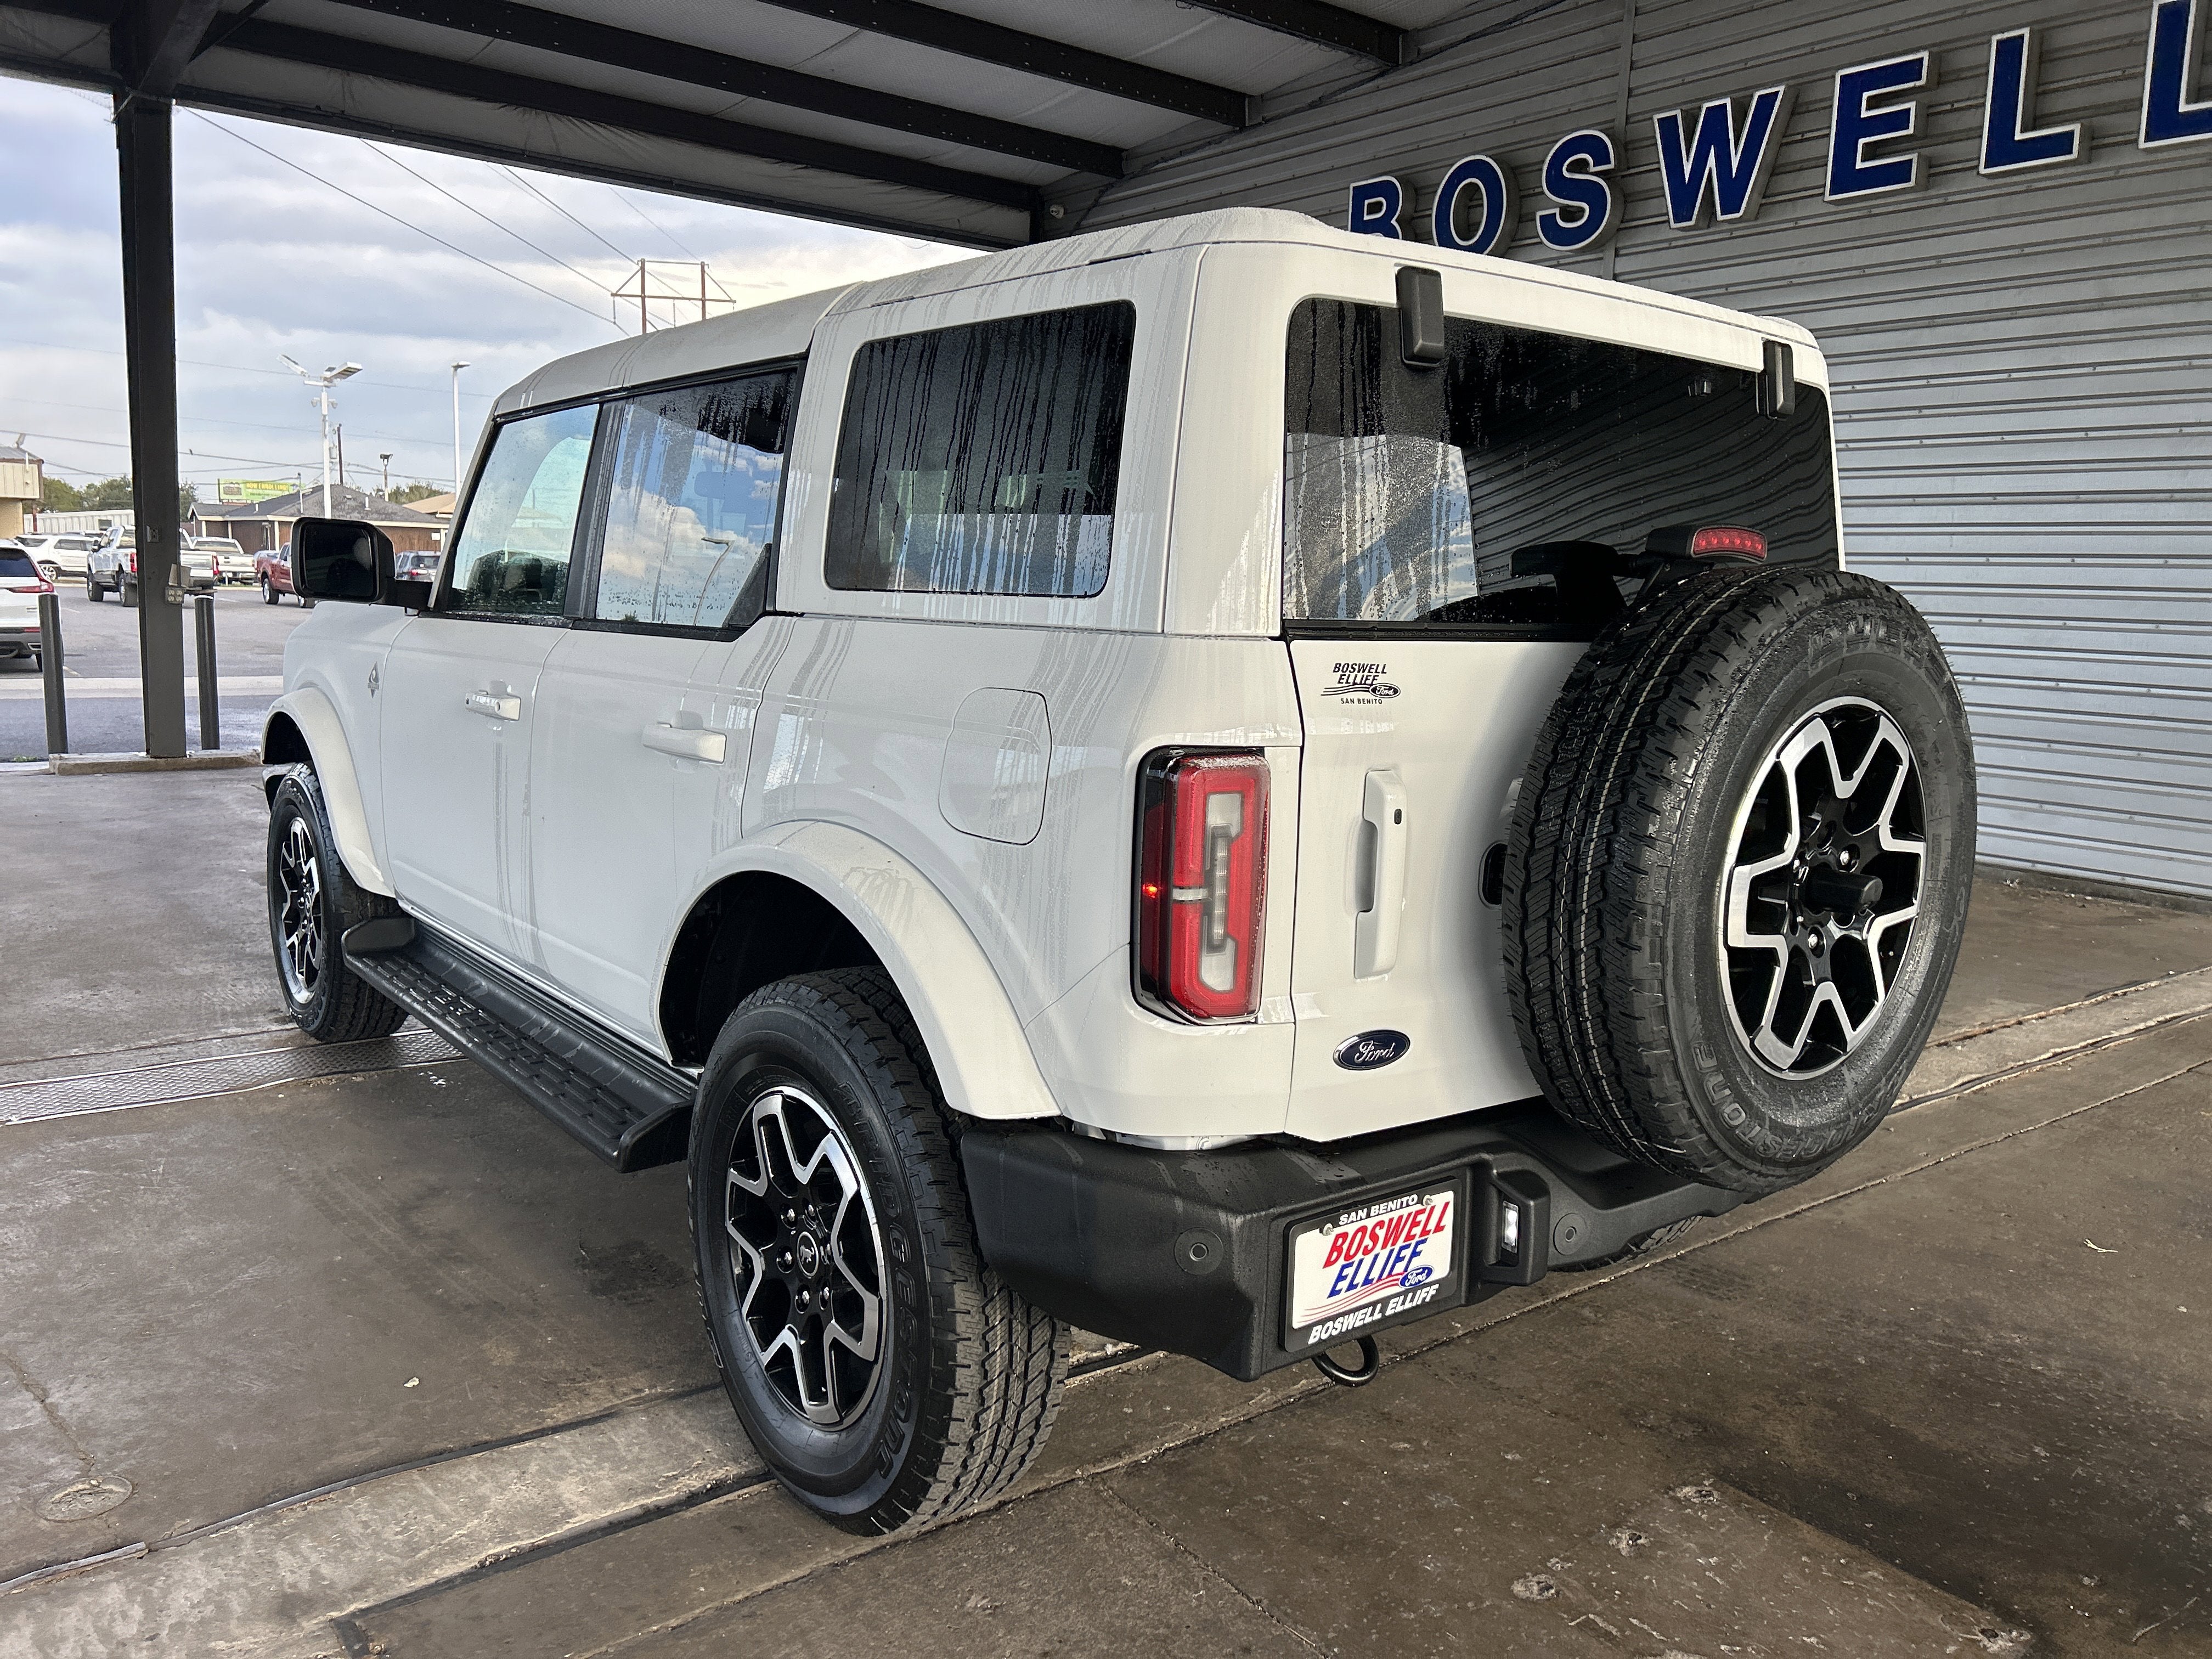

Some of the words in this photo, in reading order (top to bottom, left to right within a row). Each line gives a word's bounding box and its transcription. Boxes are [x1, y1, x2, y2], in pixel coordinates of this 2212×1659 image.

[1348, 0, 2212, 256] BOSWELL
[1333, 662, 1387, 674] BOSWELL
[1337, 674, 1379, 685] ELLIFF
[1375, 686, 1394, 695] Ford
[1354, 1040, 1395, 1063] Ford
[1339, 1210, 1367, 1226] SAN
[1369, 1193, 1419, 1218] BENITO
[1322, 1201, 1451, 1269] BOSWELL
[1327, 1237, 1429, 1299] ELLIFF
[1405, 1268, 1428, 1286] Ford
[1307, 1303, 1383, 1345] BOSWELL
[1385, 1283, 1440, 1317] ELLIFF
